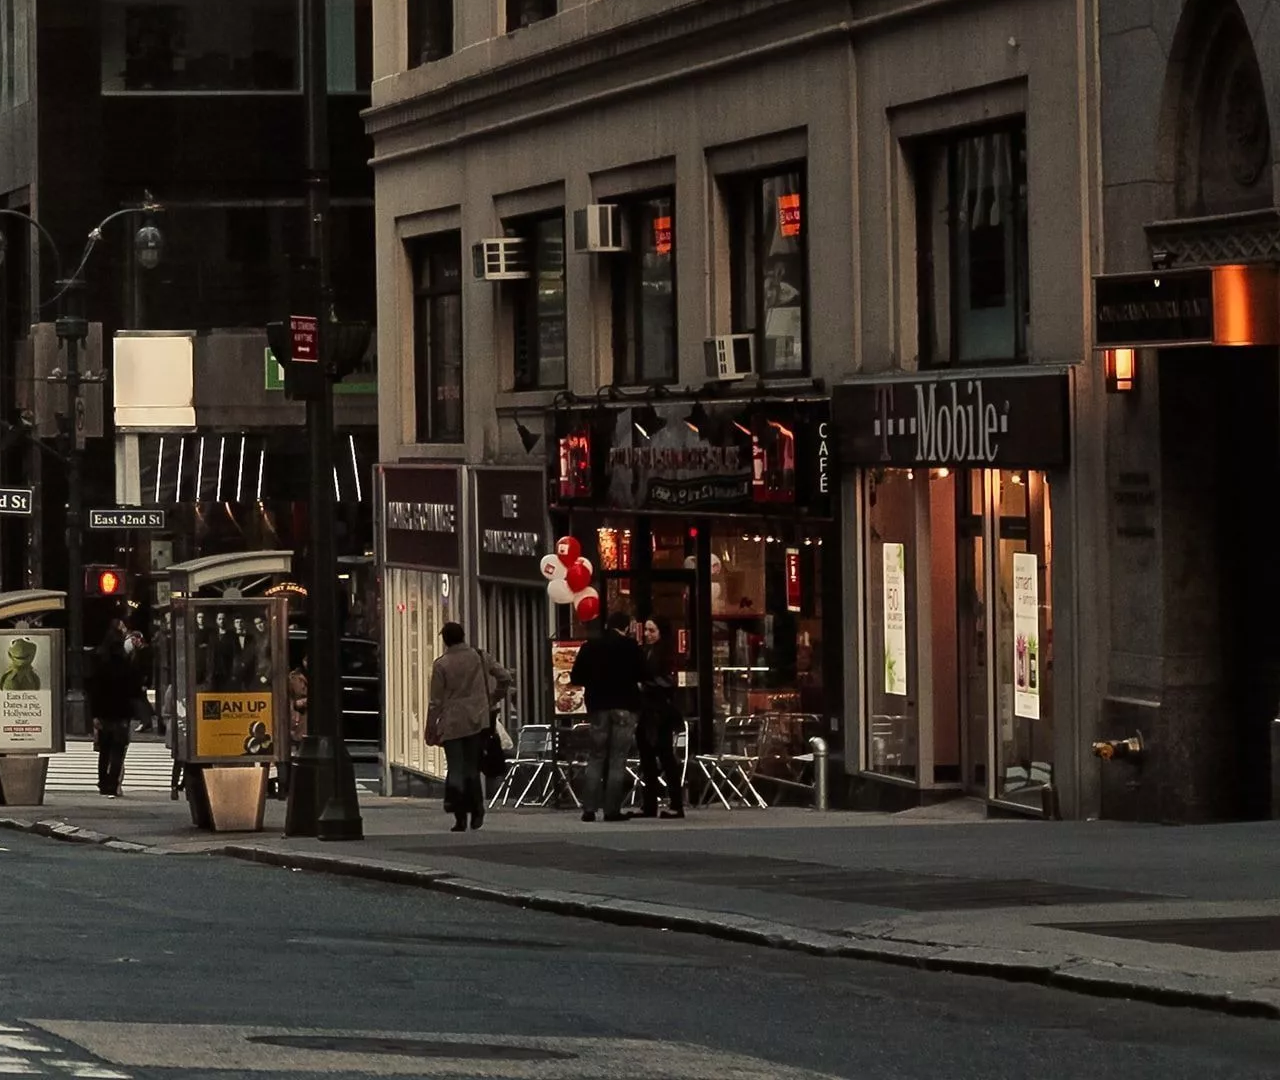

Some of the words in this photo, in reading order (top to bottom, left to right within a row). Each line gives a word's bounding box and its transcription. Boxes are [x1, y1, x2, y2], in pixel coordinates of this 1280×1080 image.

[818, 422, 829, 493] CAFÉ
[10, 495, 28, 509] St
[94, 514, 117, 525] East
[120, 514, 146, 525] 42nd
[148, 514, 161, 525] St
[247, 701, 266, 712] UP
[3, 709, 42, 718] Hollywood
